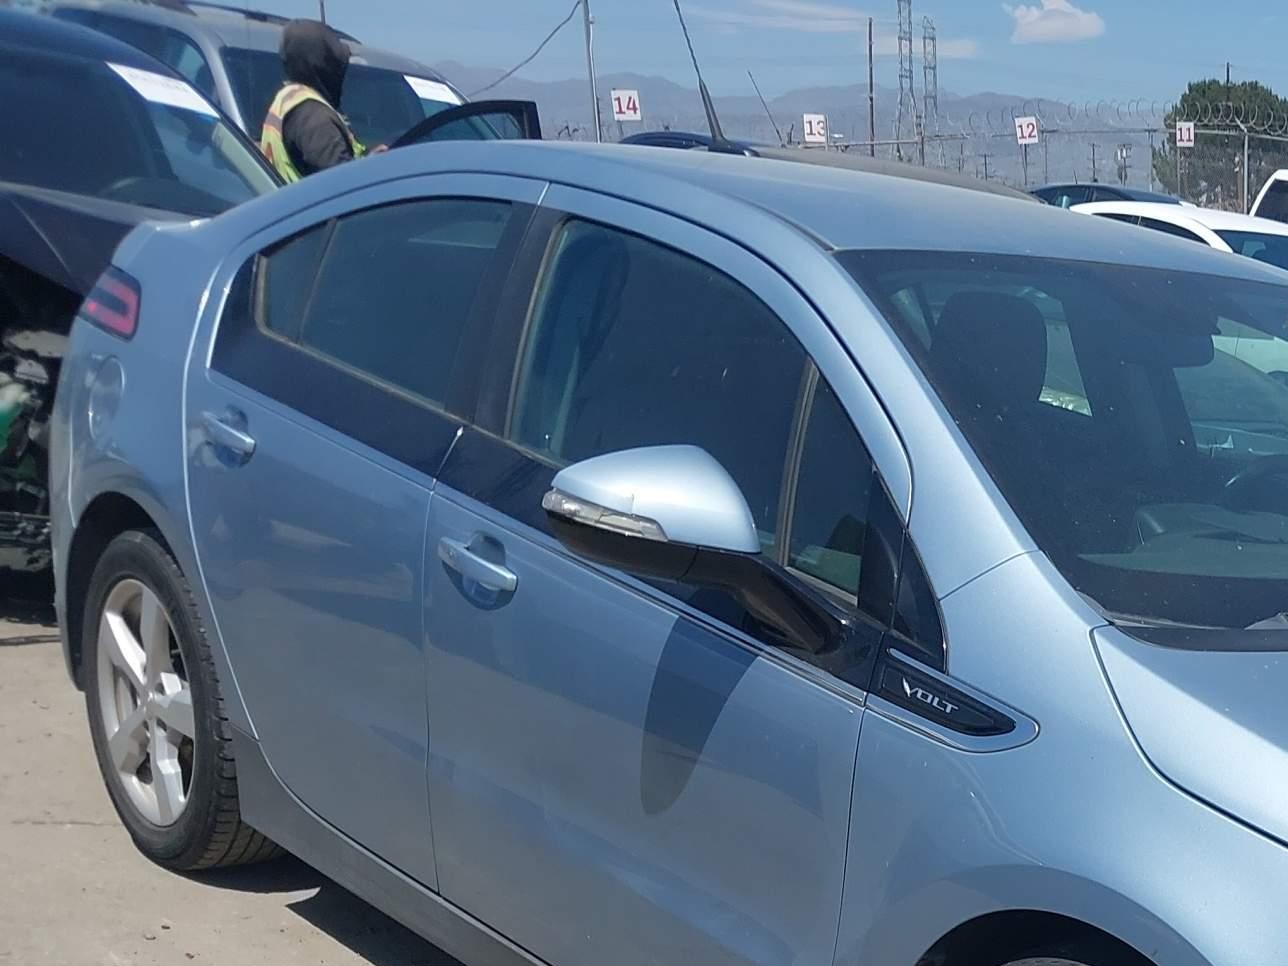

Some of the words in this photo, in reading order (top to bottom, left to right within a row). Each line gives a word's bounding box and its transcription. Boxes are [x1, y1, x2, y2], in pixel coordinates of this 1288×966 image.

[613, 96, 638, 115] 14
[806, 120, 825, 137] 13
[1017, 122, 1037, 139] 12
[1178, 127, 1193, 142] 11
[902, 677, 959, 714] VOLT
